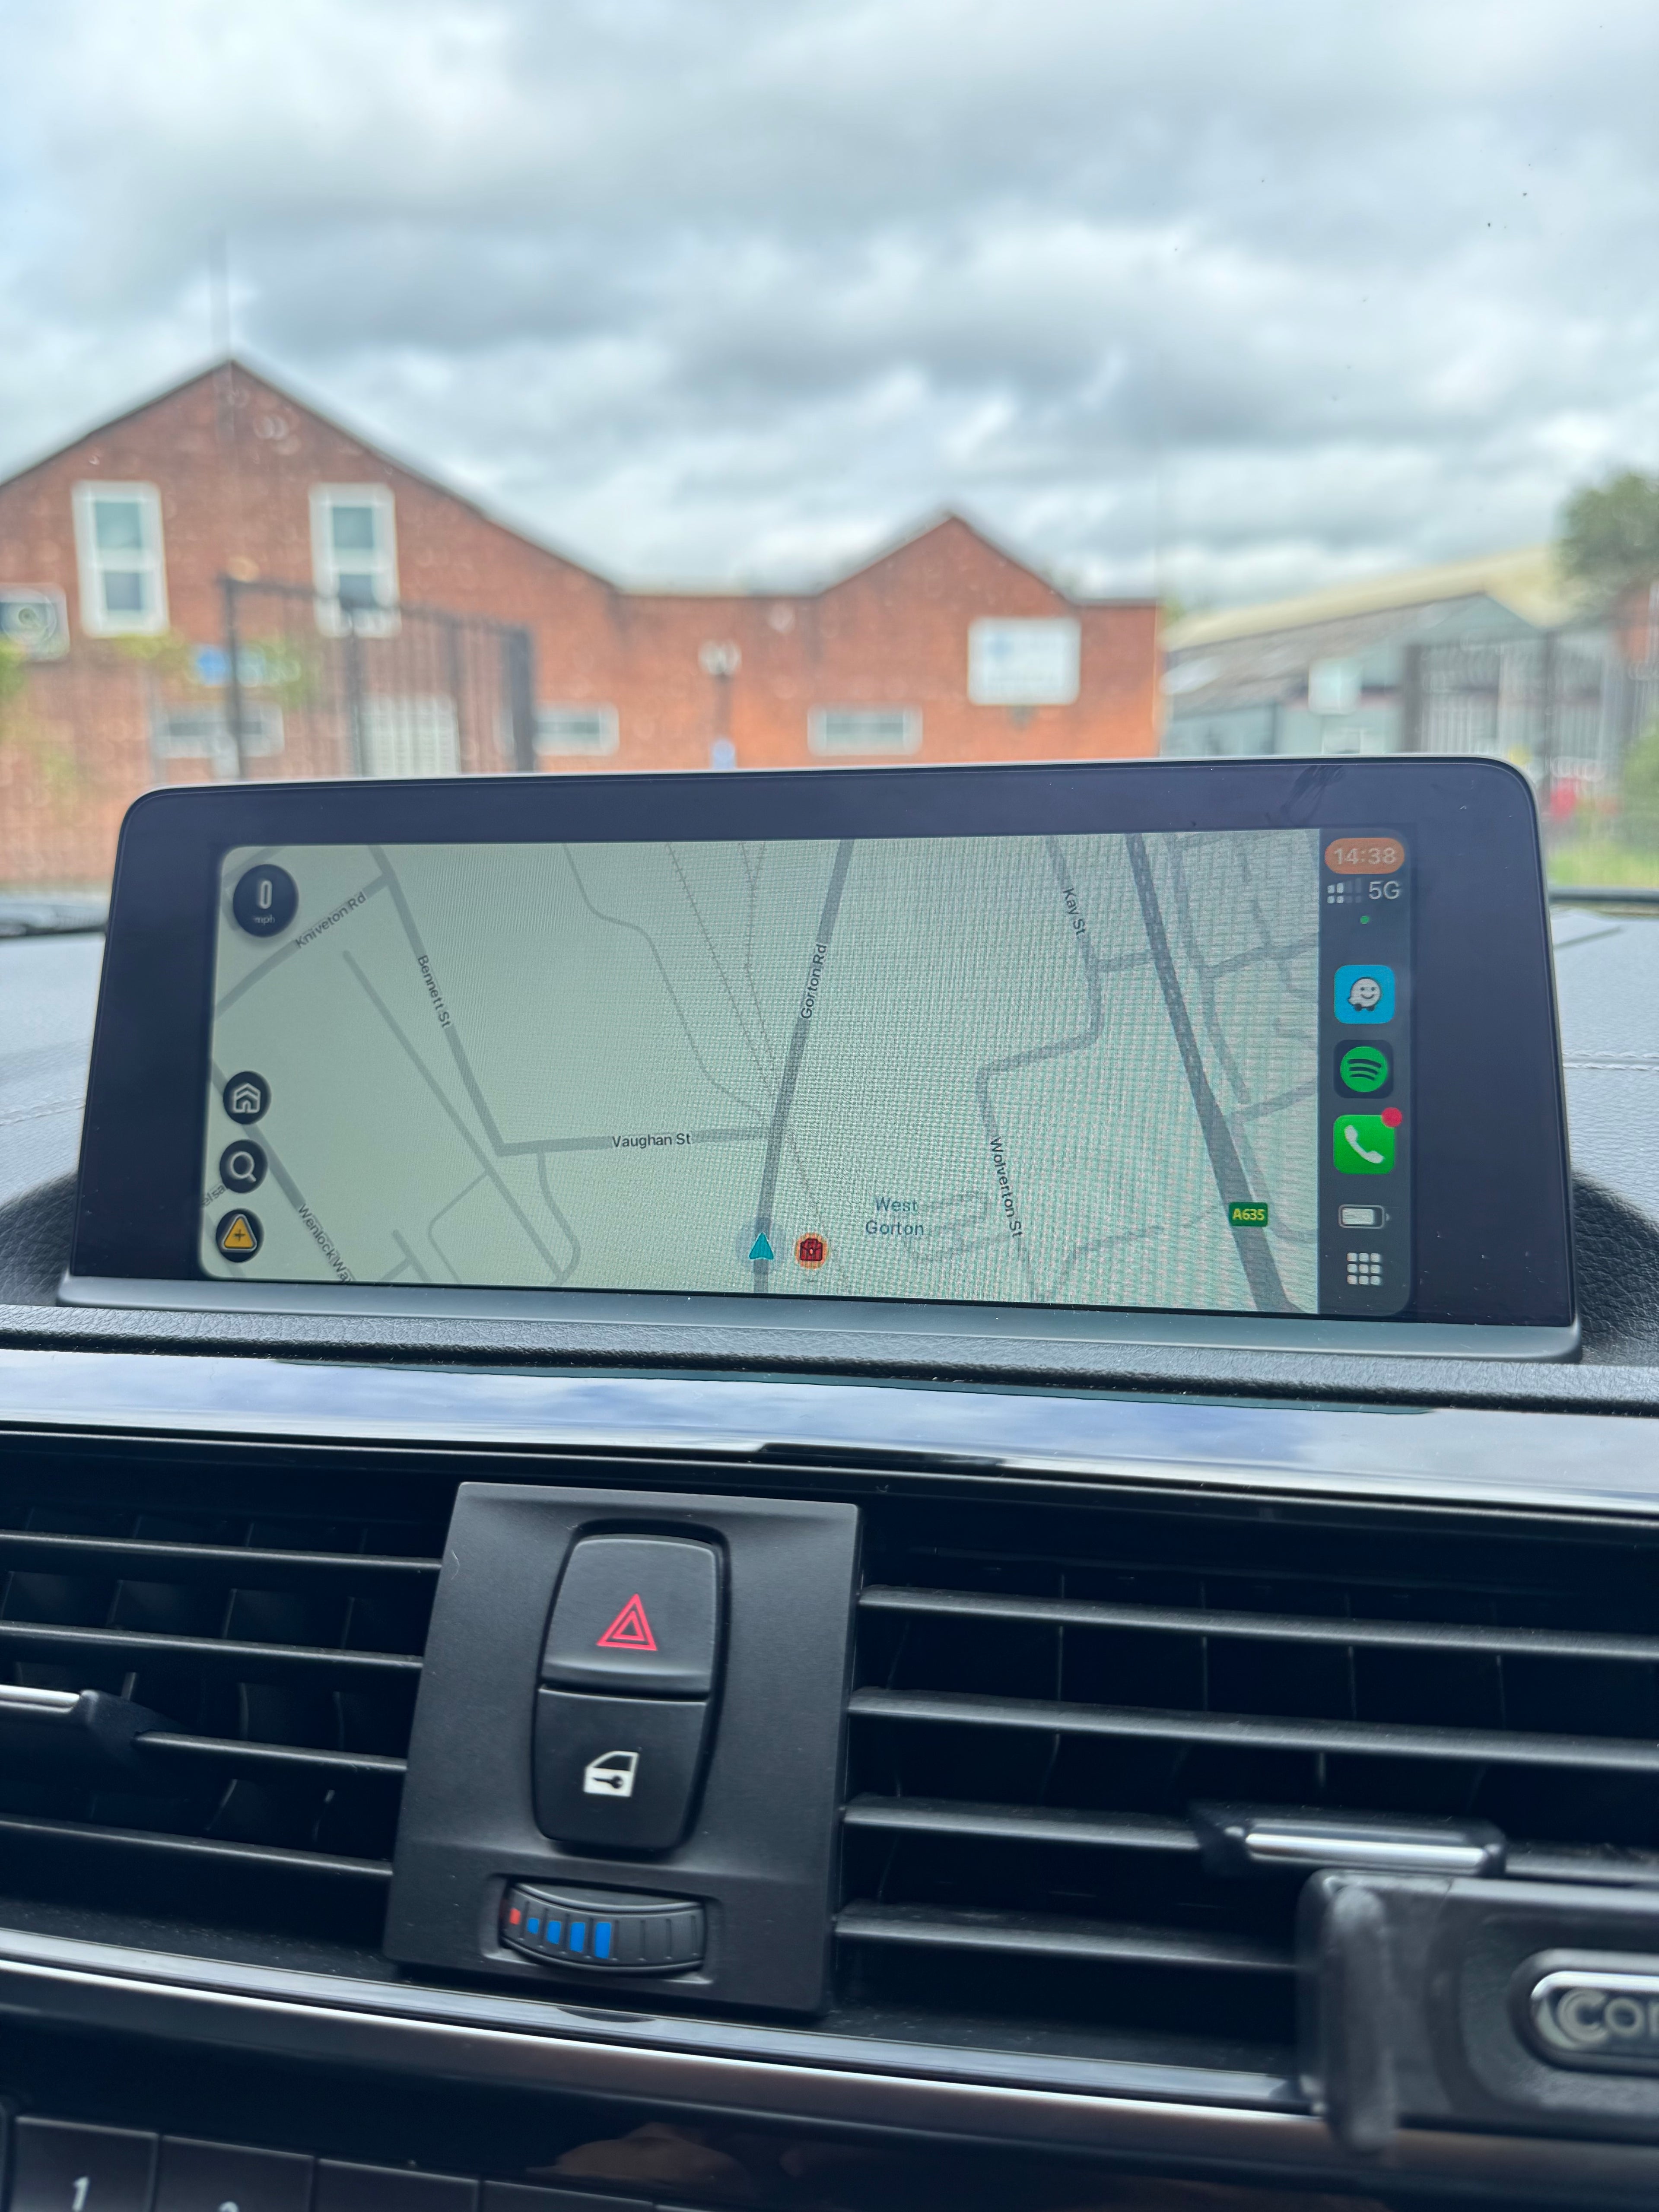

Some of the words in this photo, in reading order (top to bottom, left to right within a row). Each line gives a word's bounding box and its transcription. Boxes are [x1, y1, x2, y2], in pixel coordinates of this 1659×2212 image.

[1335, 847, 1396, 864] 14:38
[1368, 881, 1401, 900] 5G
[254, 915, 276, 925] mph
[295, 907, 349, 948] Kniveton
[347, 892, 366, 911] Rd
[1063, 888, 1079, 915] Kay
[1072, 918, 1086, 935] St
[417, 955, 443, 1010] Bennett
[438, 1011, 451, 1029] St
[801, 968, 821, 1019] Gorton
[813, 944, 827, 965] Rd
[612, 1134, 672, 1150] Vaughan
[676, 1133, 691, 1145] St
[989, 1137, 1015, 1217] Wolverton
[1009, 1220, 1023, 1237] St
[874, 1197, 917, 1211] West
[1233, 1208, 1265, 1220] A635
[299, 1203, 335, 1259] Wenlock
[865, 1220, 925, 1236] Gorton
[72, 2176, 90, 2212] 1
